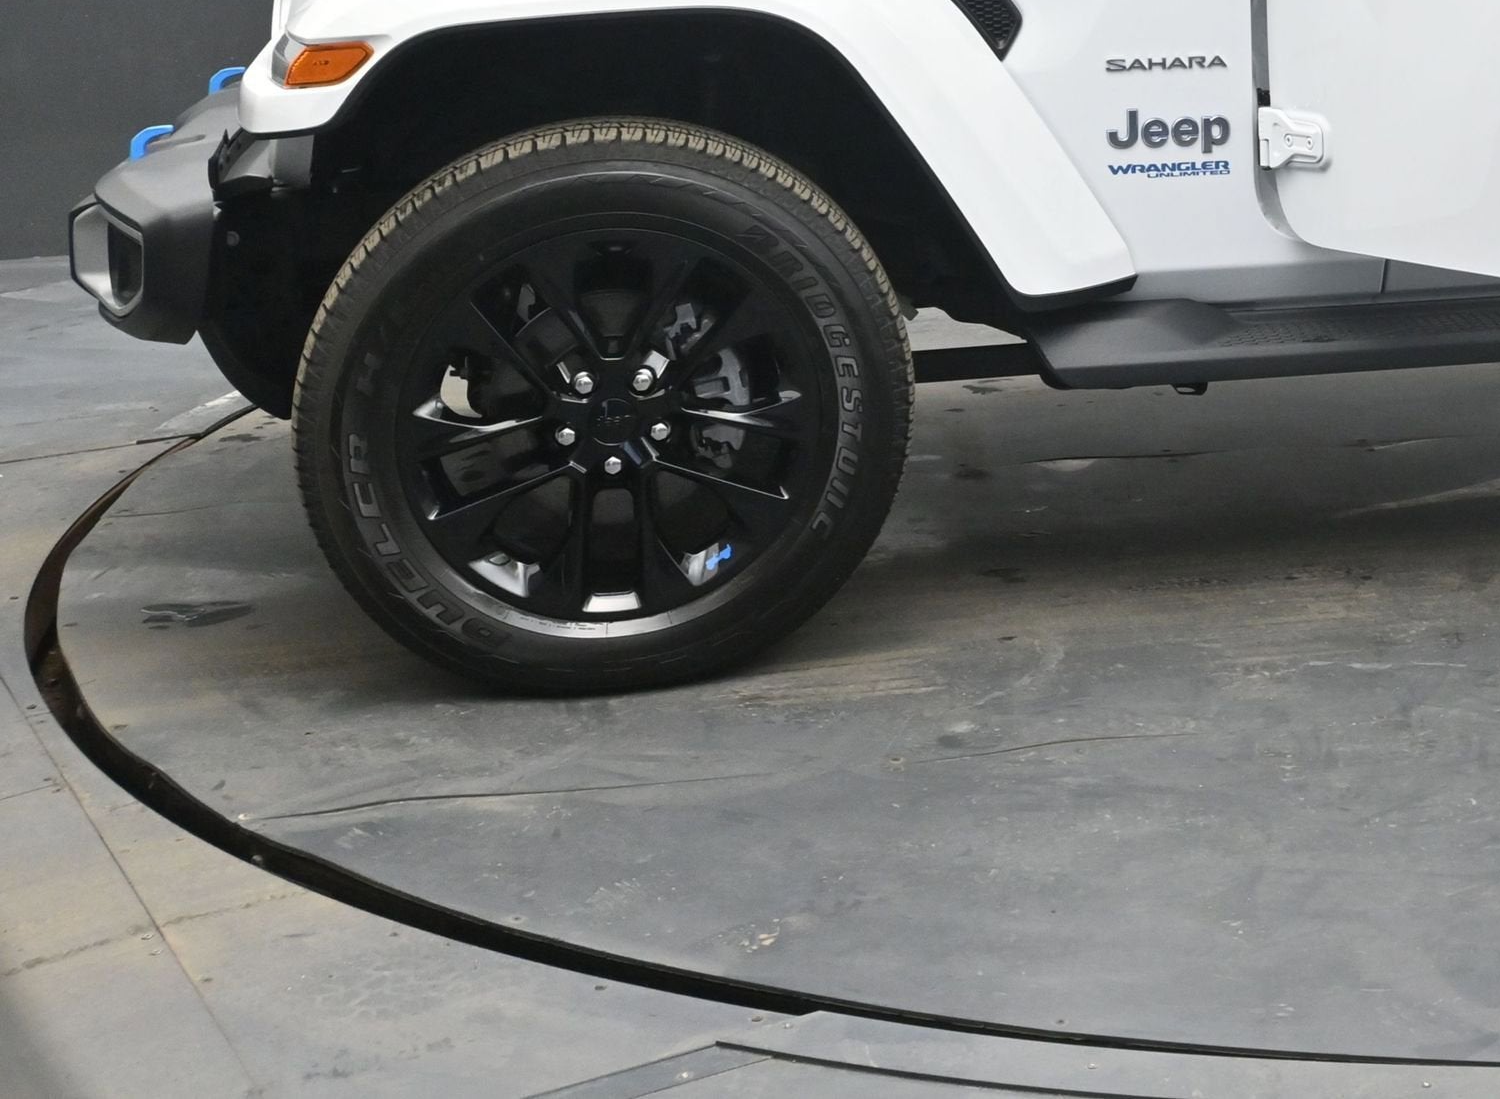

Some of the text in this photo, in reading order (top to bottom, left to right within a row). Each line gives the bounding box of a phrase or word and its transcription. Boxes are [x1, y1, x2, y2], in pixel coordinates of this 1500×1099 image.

[1105, 55, 1228, 72] SAHARA
[1106, 108, 1231, 154] Jeep
[1107, 160, 1230, 176] WRANGLER
[1147, 169, 1231, 179] UNLIMITED
